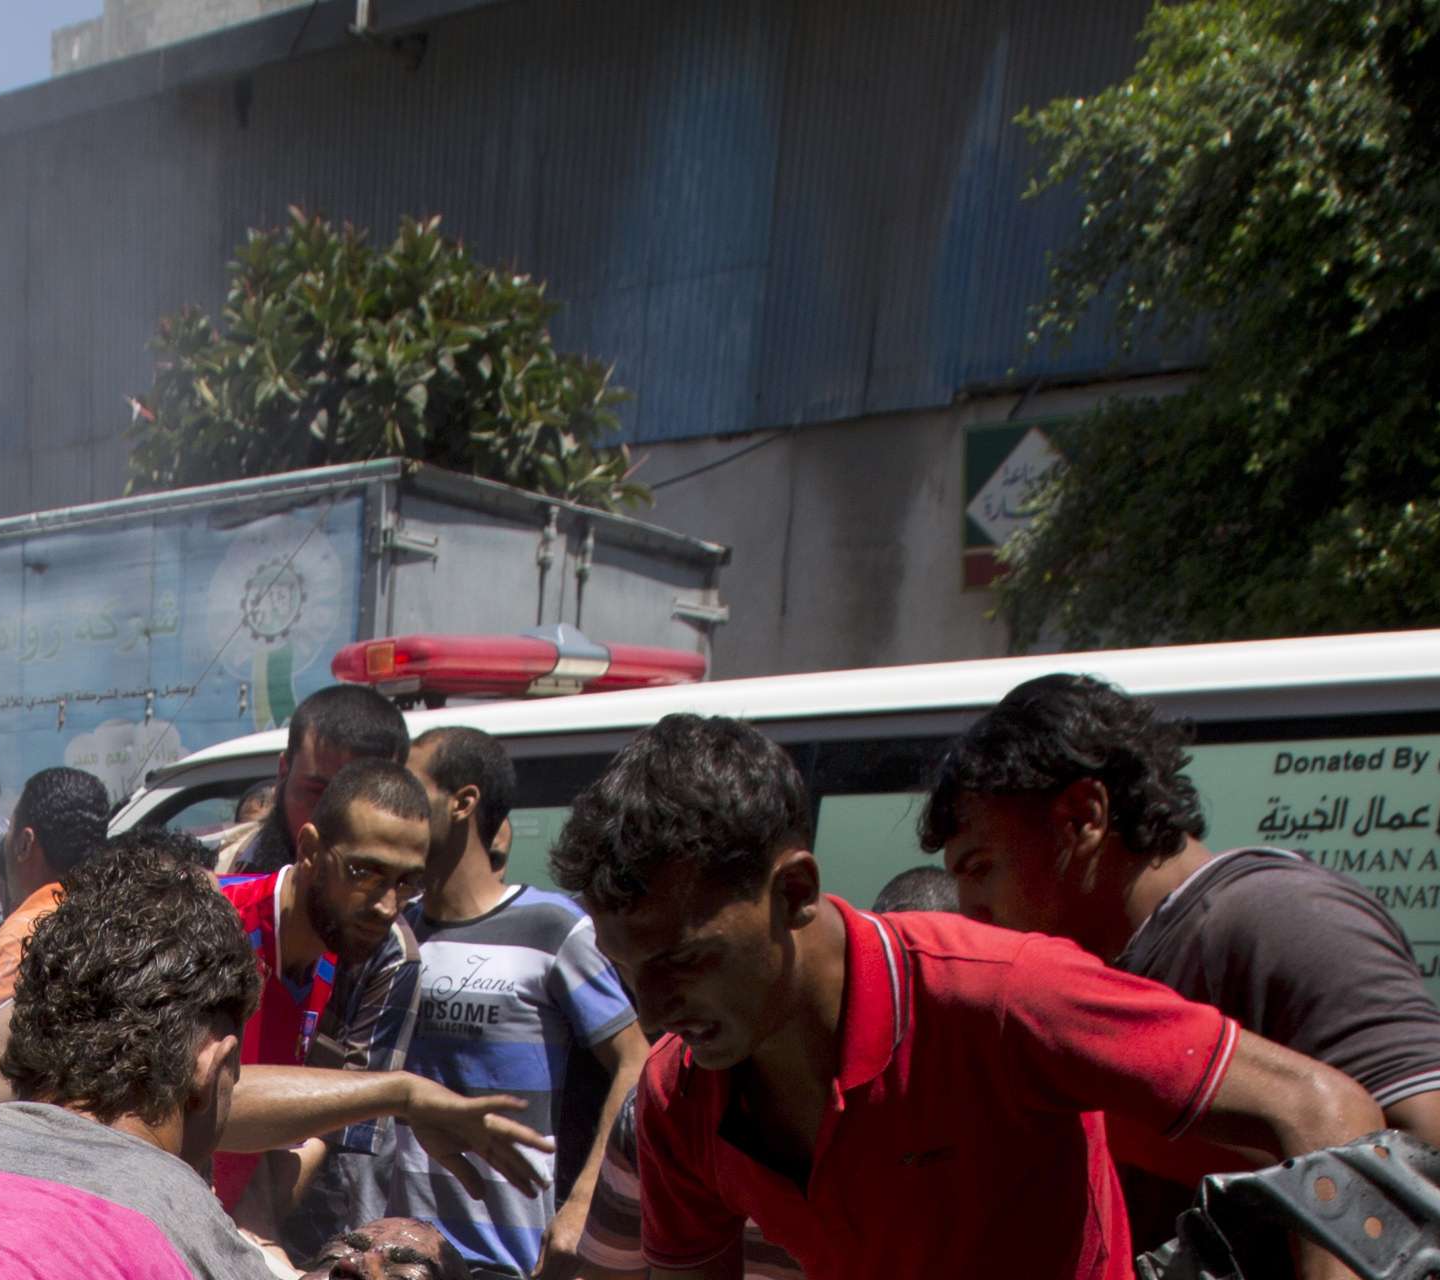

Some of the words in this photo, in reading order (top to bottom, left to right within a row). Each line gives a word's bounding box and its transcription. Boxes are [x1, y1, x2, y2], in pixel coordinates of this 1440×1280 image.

[1273, 747, 1384, 775] Donated
[1393, 746, 1429, 775] By
[1257, 793, 1350, 841] الخيرية
[1306, 847, 1412, 873] UMAN
[431, 954, 516, 1003] Jeans
[419, 1001, 500, 1025] DSOME
